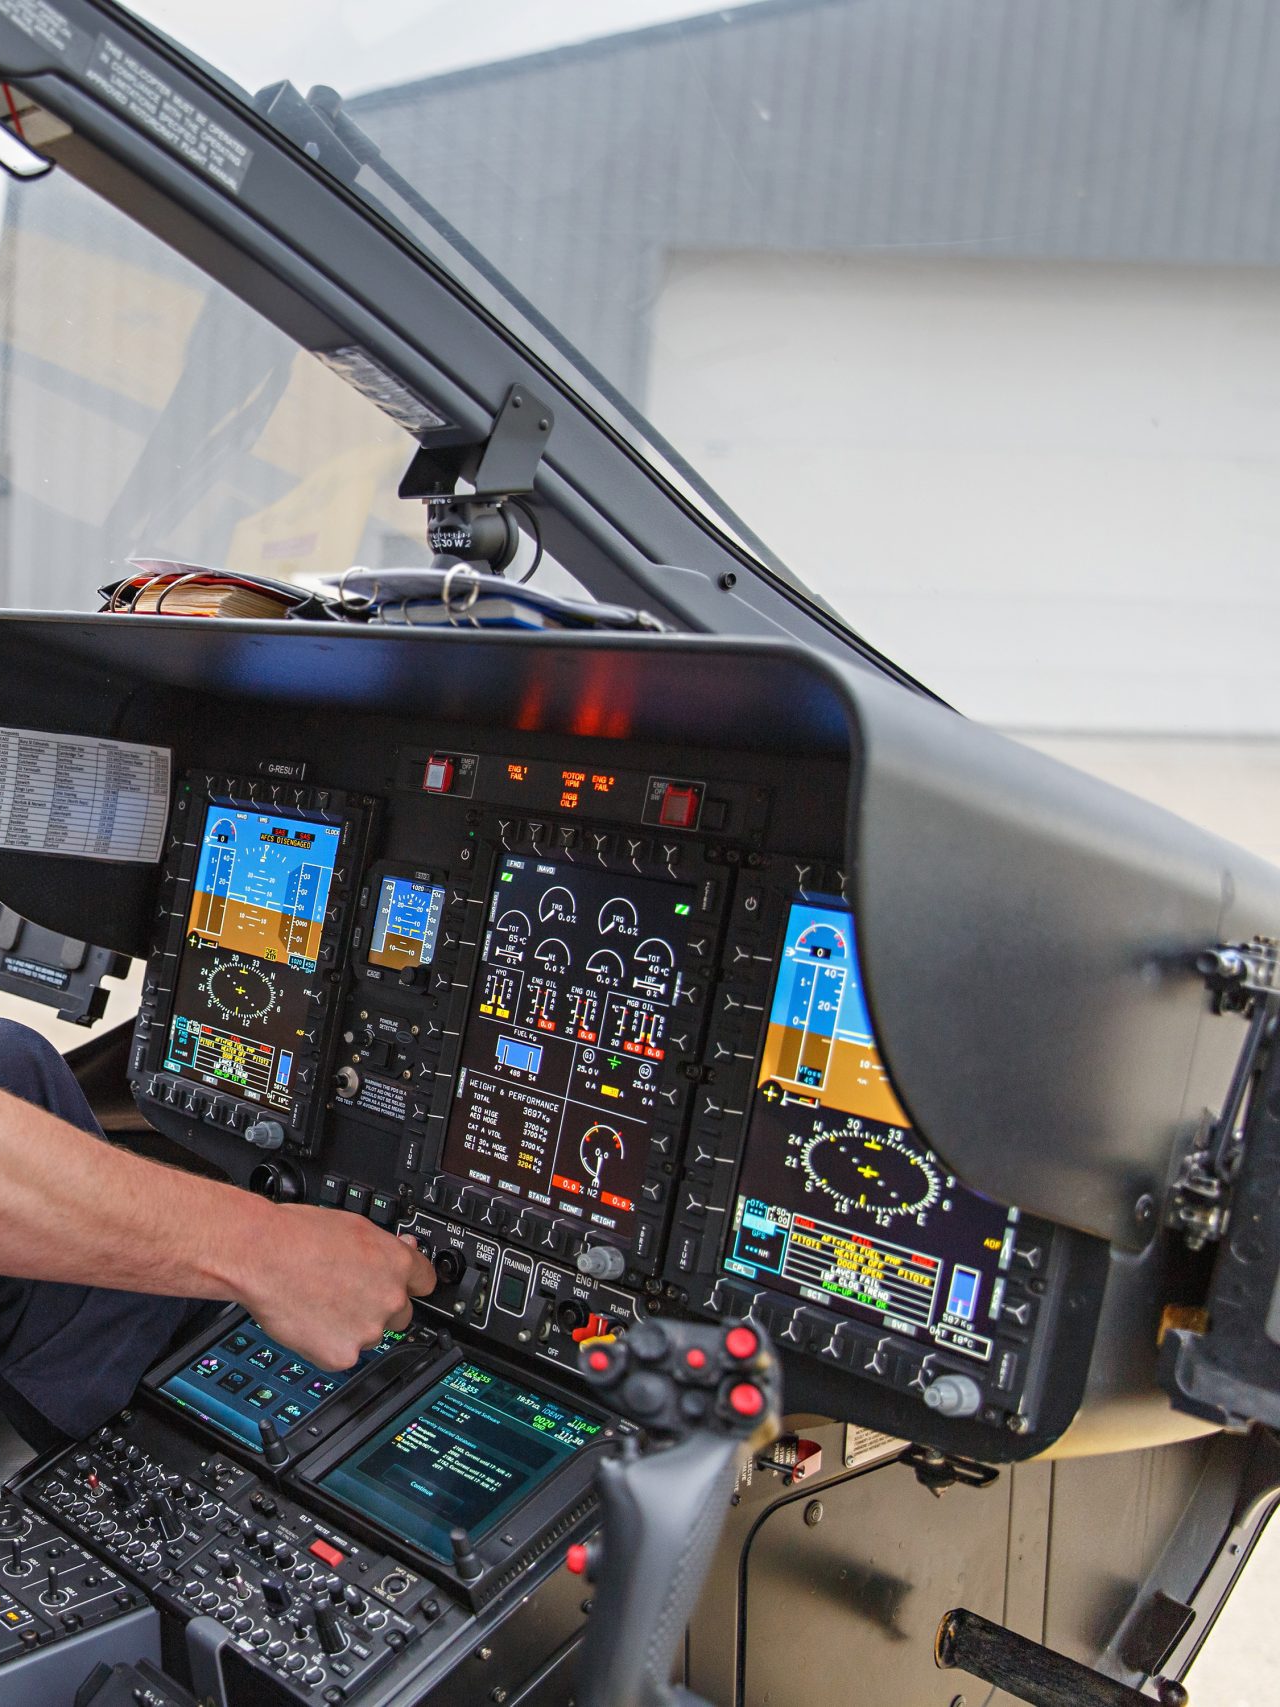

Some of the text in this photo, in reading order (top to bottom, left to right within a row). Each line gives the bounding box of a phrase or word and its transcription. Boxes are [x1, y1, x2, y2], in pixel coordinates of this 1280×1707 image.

[86, 70, 128, 105] APPROVED
[129, 102, 179, 144] ROTORCRAFT
[124, 56, 171, 96] HELICOPTER
[208, 123, 246, 156] OPERATED
[111, 61, 162, 104] COMPLIANCE
[200, 132, 241, 167] OPERATING
[158, 112, 198, 145] SPECIFIED
[454, 539, 464, 547] W
[268, 763, 293, 775] G-RESU
[508, 765, 528, 774] ENG 1
[510, 772, 523, 781] FAIL
[562, 771, 585, 781] ROTOR
[592, 775, 615, 785] ENG 2
[565, 779, 580, 788] RPM
[594, 783, 609, 792] FAIL
[560, 799, 570, 807] OIL
[562, 792, 577, 801] MGB
[274, 828, 286, 836] SAS
[299, 832, 311, 840] SAS
[325, 828, 340, 836] CLOCK
[260, 833, 312, 849] AFCS DISENGAGED
[551, 903, 563, 911] TRQ
[548, 953, 556, 961] N1
[648, 954, 660, 963] TOT
[531, 977, 557, 989] ENG OIL
[571, 986, 598, 998] ENG OIL
[626, 999, 655, 1012] MGB OIL
[379, 1018, 398, 1027] POWERLINE
[379, 1023, 397, 1032] DETECTOR
[514, 1029, 537, 1042] FUEL Kg
[470, 1079, 559, 1113] WEIGHT & PERFORMANCE
[474, 1093, 491, 1103] TOTAL
[471, 1105, 482, 1114] AEO
[484, 1109, 499, 1119] HIGE
[470, 1112, 481, 1121] AEO
[482, 1116, 497, 1126] HOGE
[468, 1123, 479, 1132] CAT
[487, 1129, 502, 1140] VTOL
[465, 1134, 476, 1143] OEI
[492, 1142, 507, 1152] HOGE
[464, 1141, 475, 1150] OEI
[494, 1149, 509, 1161] HOGE
[469, 1169, 491, 1183] REPORT
[501, 1181, 513, 1191] EPC
[528, 1190, 551, 1205] STATUS
[587, 1188, 598, 1198] N2
[562, 1203, 579, 1214] CONF
[591, 1212, 616, 1228] WEIGHT
[415, 1225, 432, 1237] FLIGHT
[447, 1223, 461, 1235] ENG
[450, 1237, 464, 1249] VENT
[476, 1242, 495, 1256] FADEC
[476, 1250, 493, 1263] EMER
[821, 1235, 903, 1266] AFT+FWD FUEL PMP
[504, 1256, 531, 1274] TRAINING
[792, 1233, 932, 1286] PITOT1 HEATER OFF PITOT2
[541, 1267, 562, 1283] FADEC
[837, 1258, 884, 1280] DOOR OPEN
[541, 1278, 559, 1290] EMER
[575, 1273, 599, 1290] ENG II
[860, 1275, 880, 1288] FAIL
[573, 1287, 590, 1300] VENT
[822, 1281, 888, 1310] PWR-UP TST OK
[838, 1277, 860, 1291] CLOG
[863, 1284, 889, 1301] TREND
[610, 1304, 631, 1318] FLIGHT
[552, 1323, 560, 1333] ON
[930, 1326, 947, 1339] OAT
[548, 1346, 559, 1358] OFF
[517, 1395, 534, 1408] 19:57
[463, 1402, 481, 1415] Installed
[481, 1411, 500, 1424] Software
[542, 1408, 564, 1420] IDENT
[533, 1415, 556, 1428] 0020
[410, 1481, 433, 1496] Continue
[299, 1514, 312, 1524] ELT
